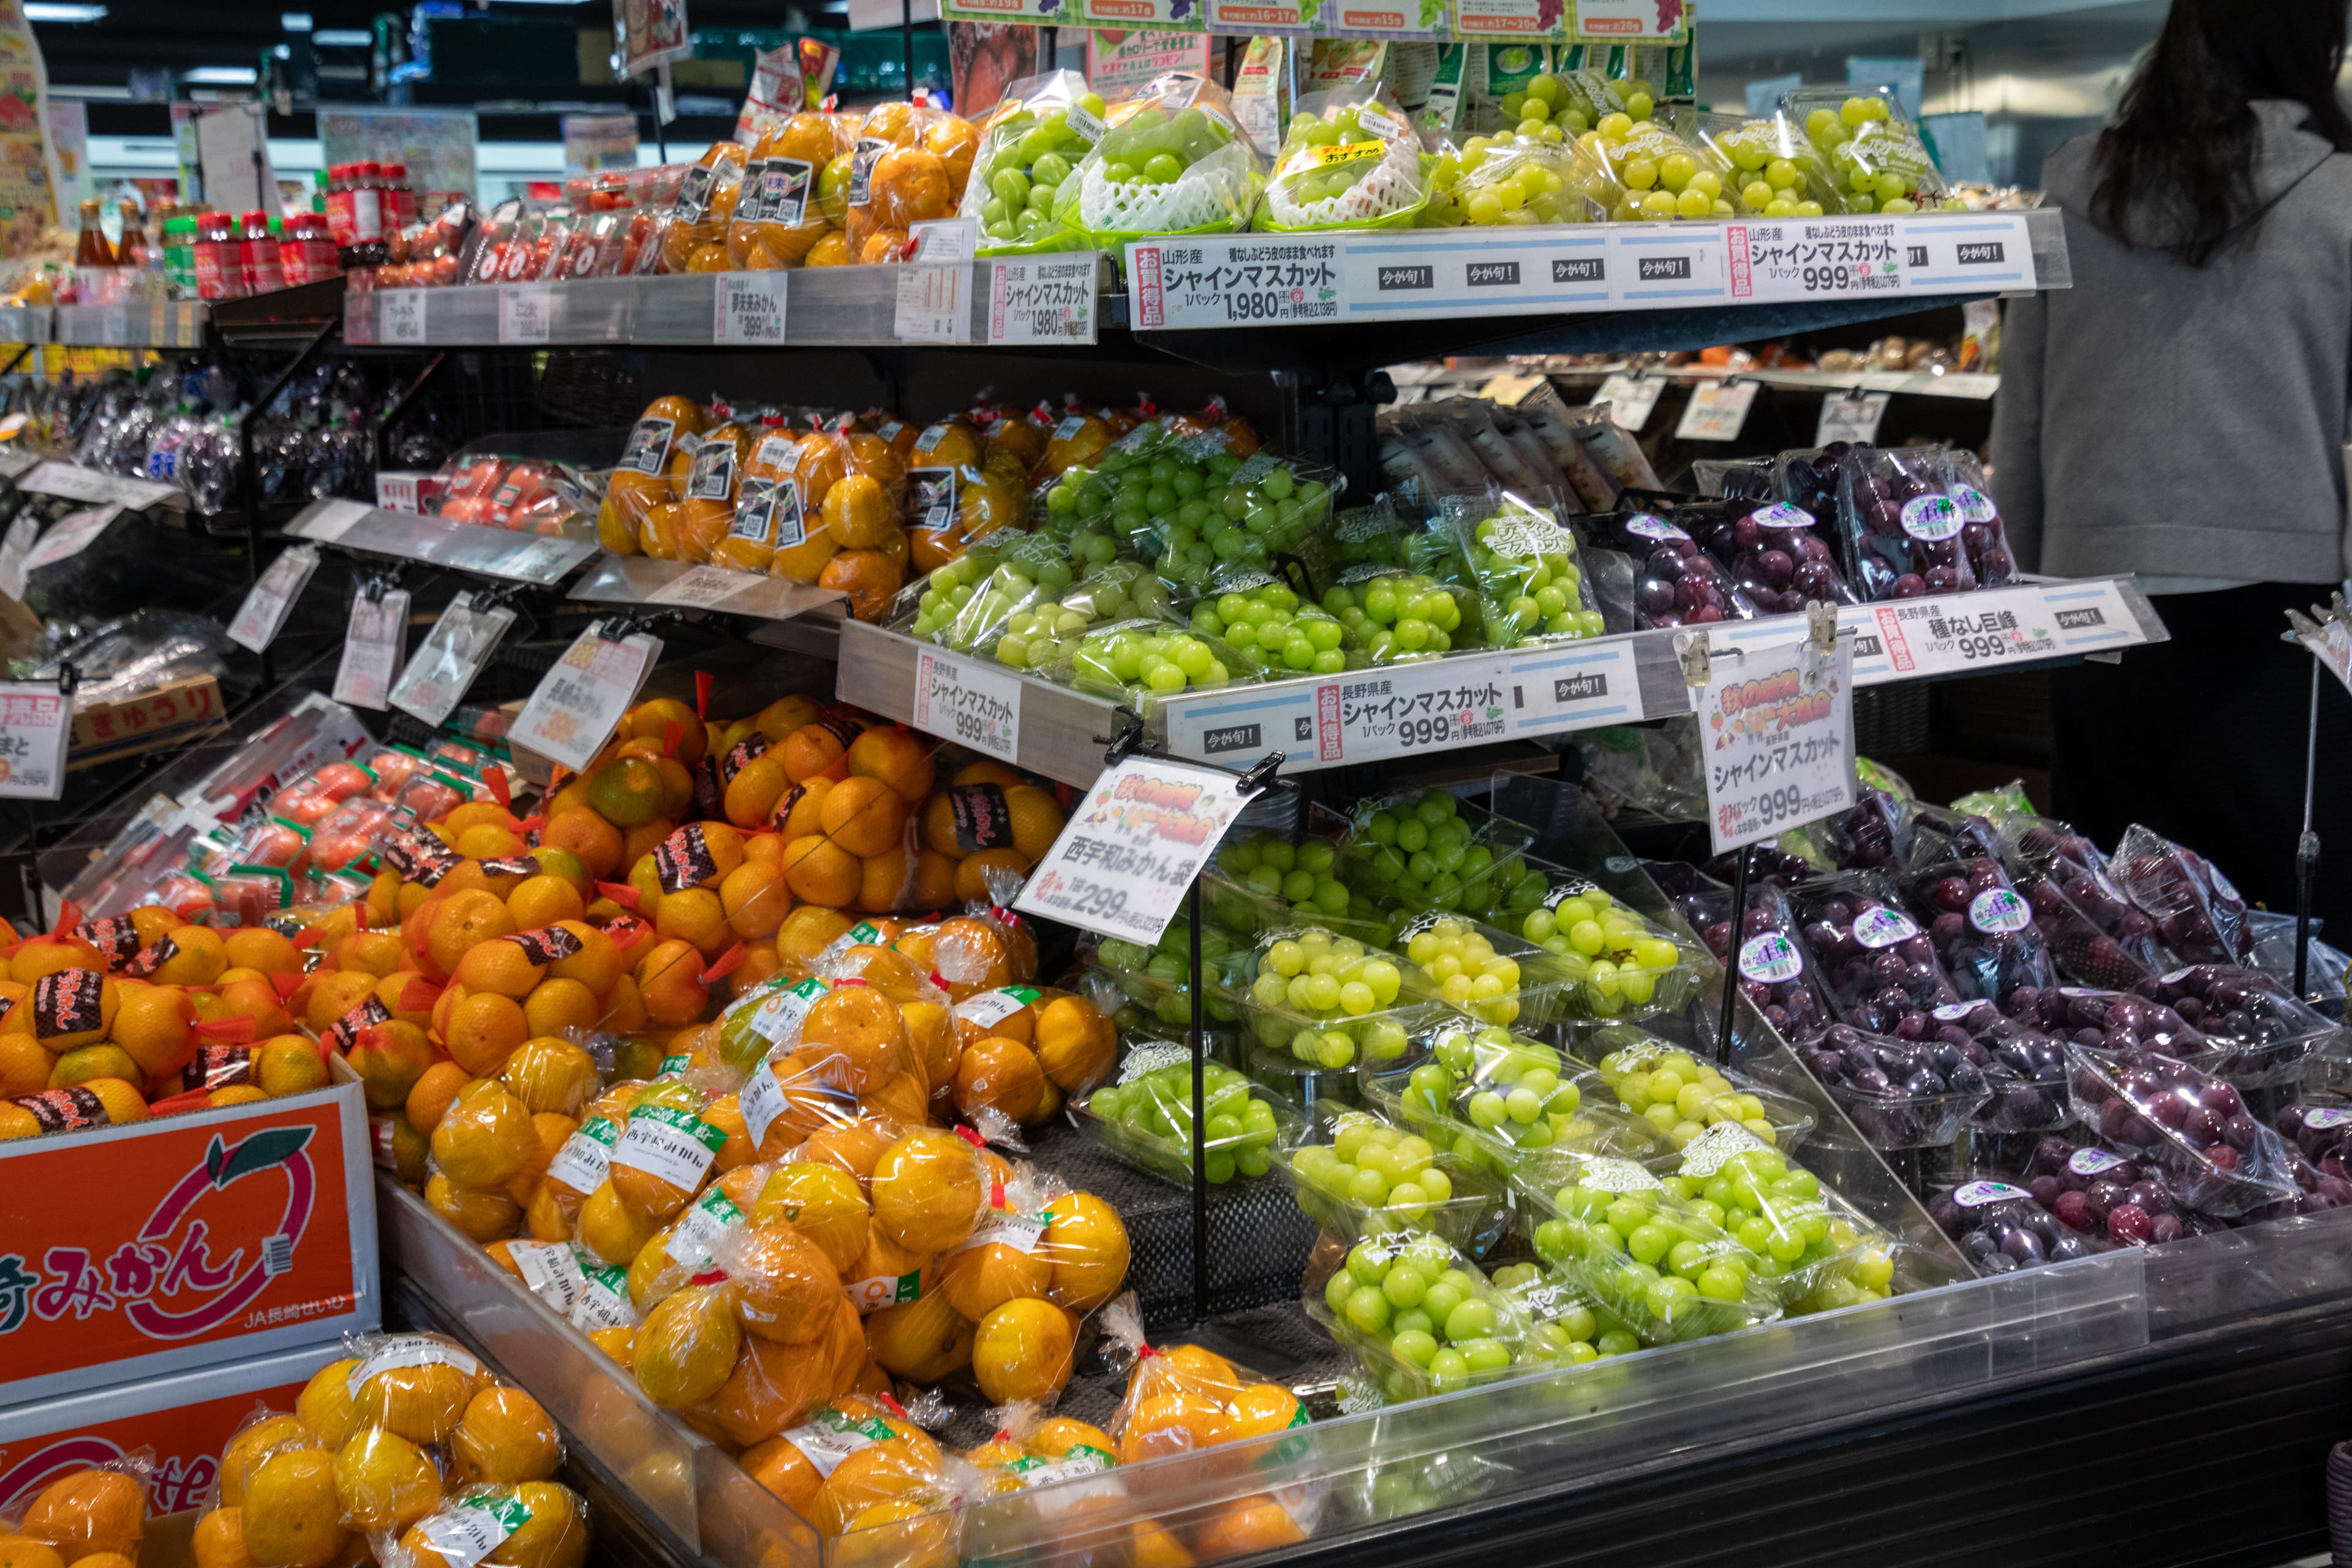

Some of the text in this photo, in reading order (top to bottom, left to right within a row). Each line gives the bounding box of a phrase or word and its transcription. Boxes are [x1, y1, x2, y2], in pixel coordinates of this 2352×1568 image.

[1325, 147, 1380, 163] おすすめ
[1749, 224, 1895, 242] 山形産 種なしぶどう皮のまま食べれます
[1162, 244, 1335, 265] 山形産 種なしぶどう皮のまま食べれます
[1729, 227, 1750, 295] お買得品
[1751, 238, 1898, 266] シャインマスカット
[1164, 262, 1336, 292] シャインマスカット
[1382, 268, 1426, 285] 今が旬!
[1470, 265, 1513, 281] 今が旬!
[1555, 261, 1597, 277] 今が旬!
[1642, 260, 1684, 276] 今が旬!
[1769, 266, 1800, 279] 1パック
[1803, 265, 1849, 291] 999
[1851, 281, 1858, 291] 円
[1006, 280, 1089, 307] シャインマスカット
[1138, 250, 1162, 325] お買得品
[731, 293, 777, 314] 夢未来みかん
[1185, 292, 1221, 306] 1パック
[1224, 291, 1279, 322] 1,980
[1280, 309, 1289, 319] 円
[743, 315, 763, 337] 399
[1032, 308, 1058, 337] 1,980
[1898, 604, 1942, 621] 長野県産
[1928, 609, 2019, 639] 種なし巨峰
[1879, 610, 1914, 671] お買得品
[1924, 638, 1954, 653] 1パック
[1959, 635, 2006, 660] 999
[933, 661, 957, 682] 長野県産
[931, 677, 1014, 724] シャインマスカット
[1341, 679, 1393, 701] 長野県産
[1556, 677, 1603, 698] 今が旬!
[91, 685, 214, 740] きゅうり
[1344, 682, 1503, 726] シャインマスカット
[956, 711, 982, 742] 999
[1207, 725, 1253, 749] 今が旬!
[1320, 688, 1341, 760] お買得品
[1362, 722, 1396, 739] 1パック
[1399, 716, 1450, 747] 999
[1451, 731, 1460, 742] 円
[1714, 729, 1840, 794] シャインマスカット
[1728, 796, 1757, 819] 1パック
[1758, 784, 1801, 826] 999
[1061, 834, 1197, 888] 西宇和みかん袋
[1071, 883, 1128, 919] 299
[244, 1295, 346, 1329] JA長崎せいひ
